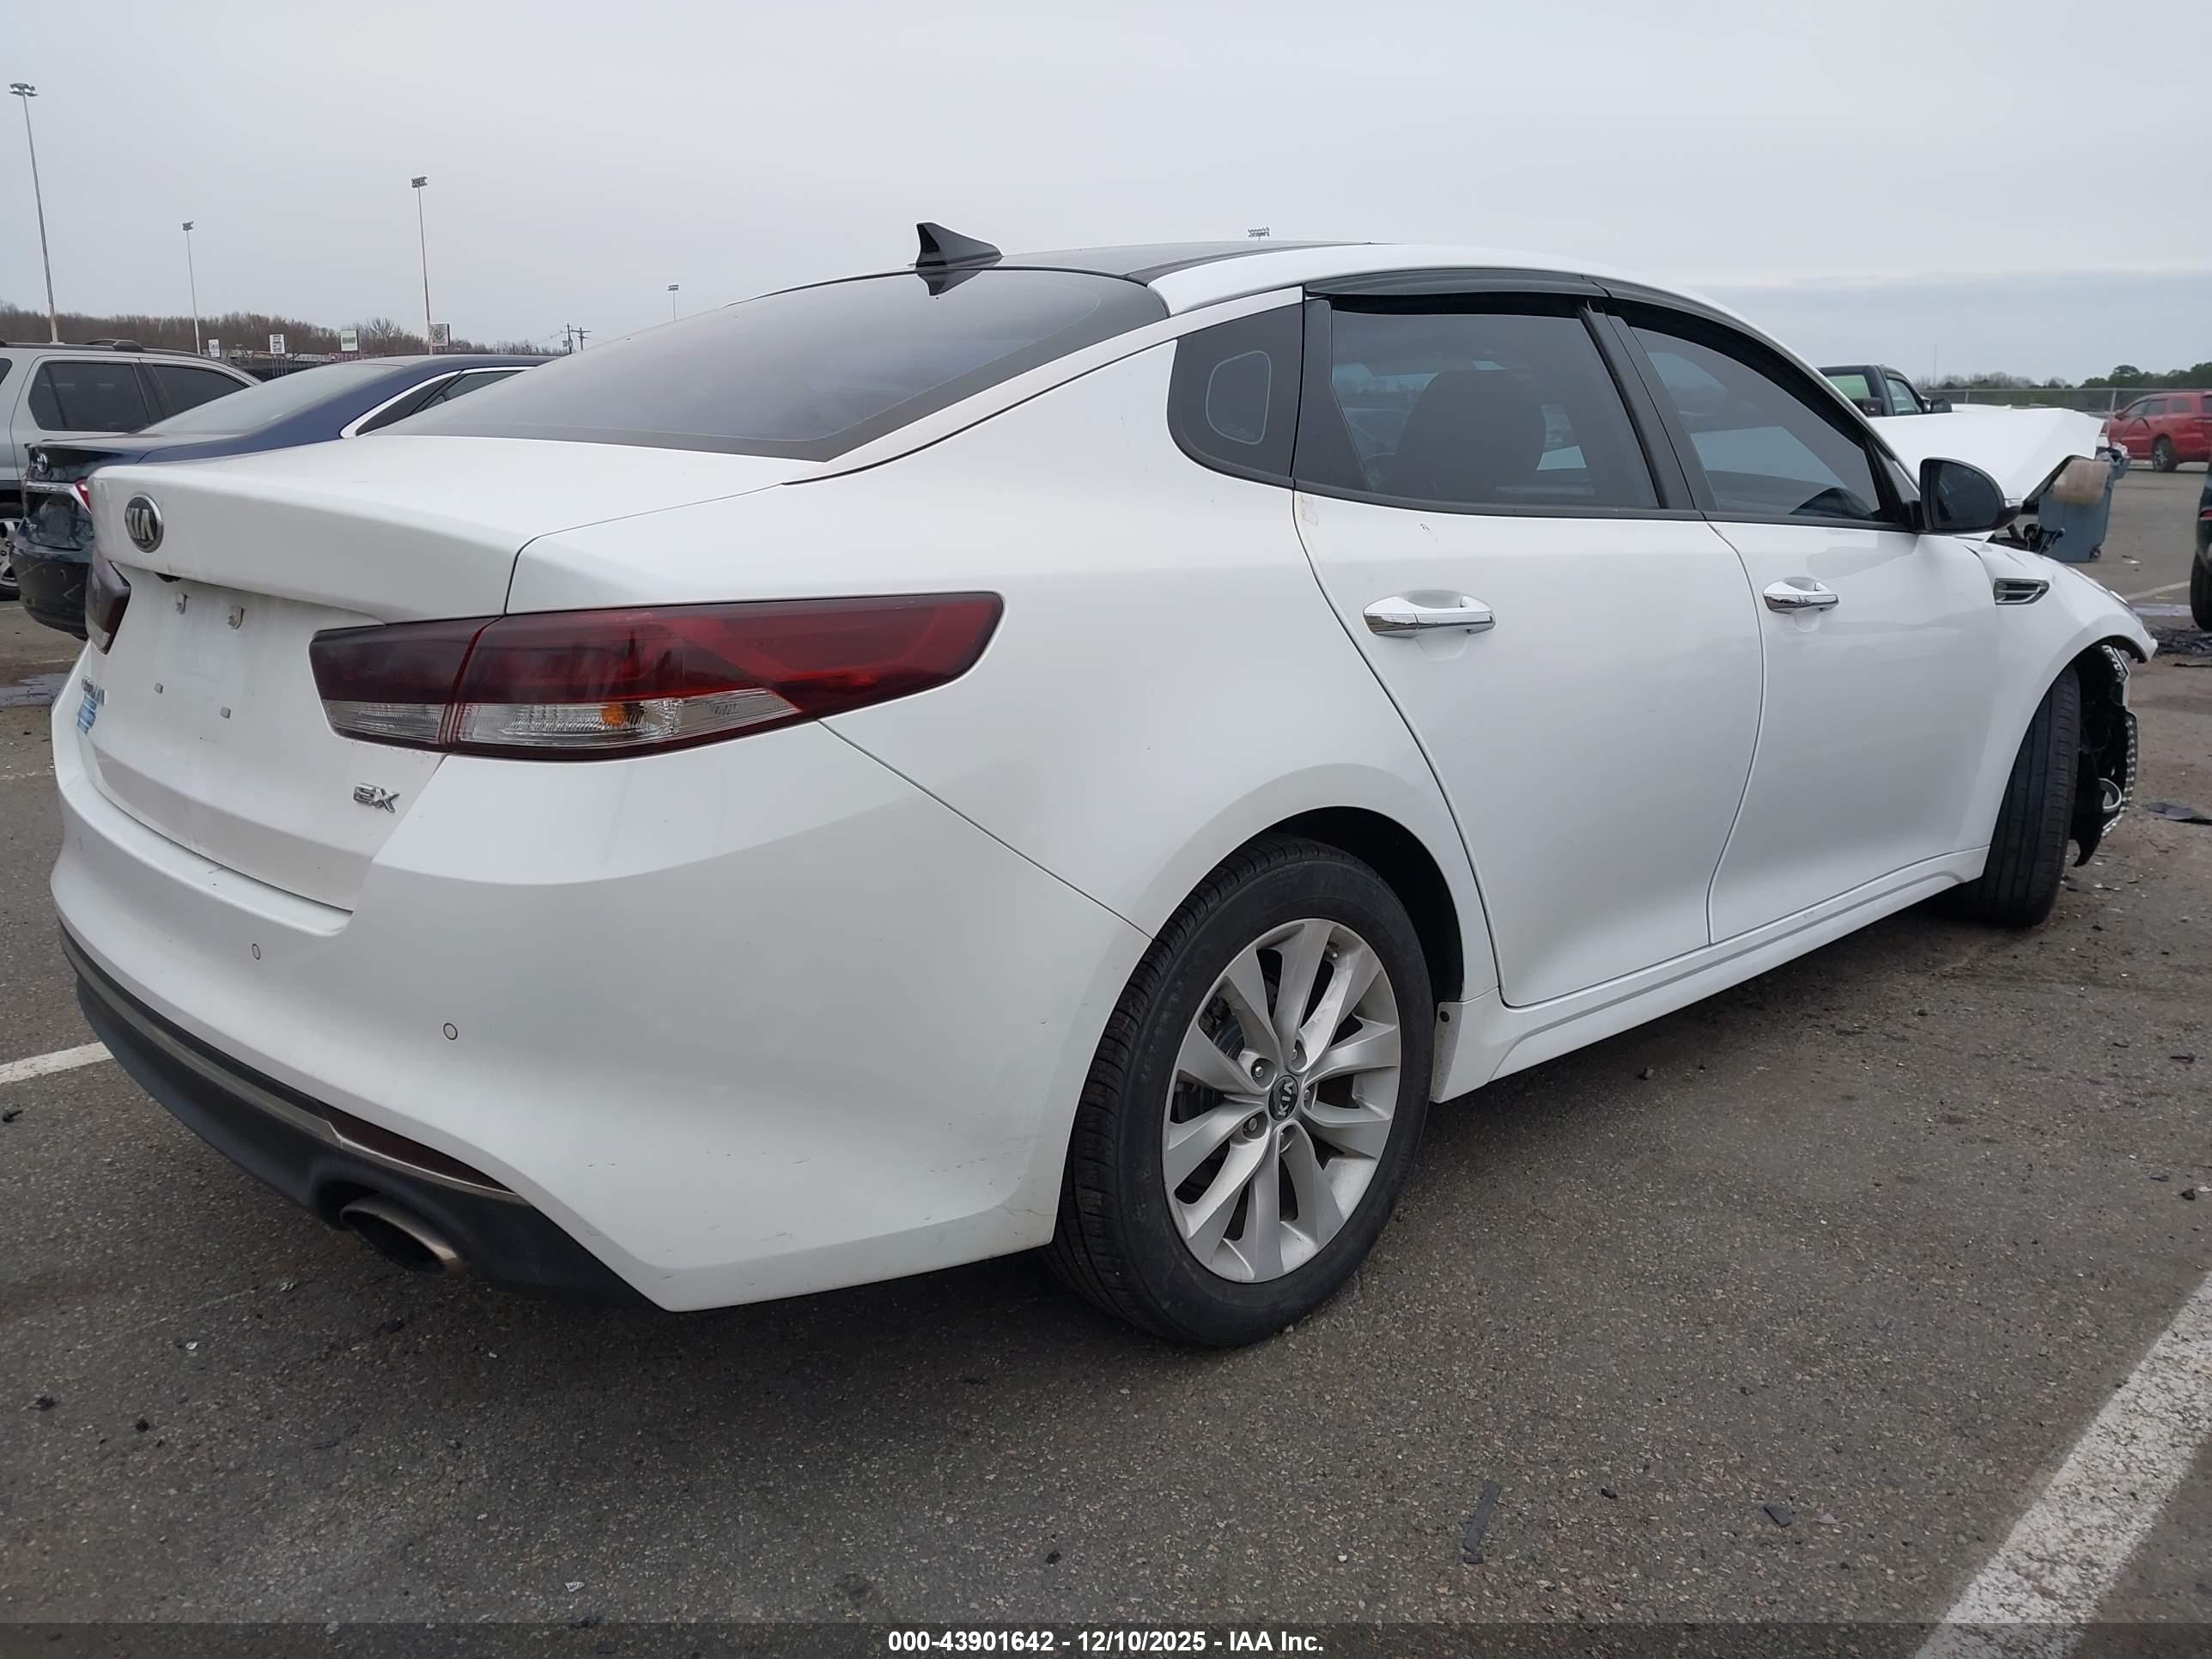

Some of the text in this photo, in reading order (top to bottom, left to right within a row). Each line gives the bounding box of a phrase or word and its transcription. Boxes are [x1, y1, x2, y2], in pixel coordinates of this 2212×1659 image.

[126, 507, 155, 541] KIA
[353, 782, 401, 813] EX
[1278, 1082, 1293, 1116] KIA
